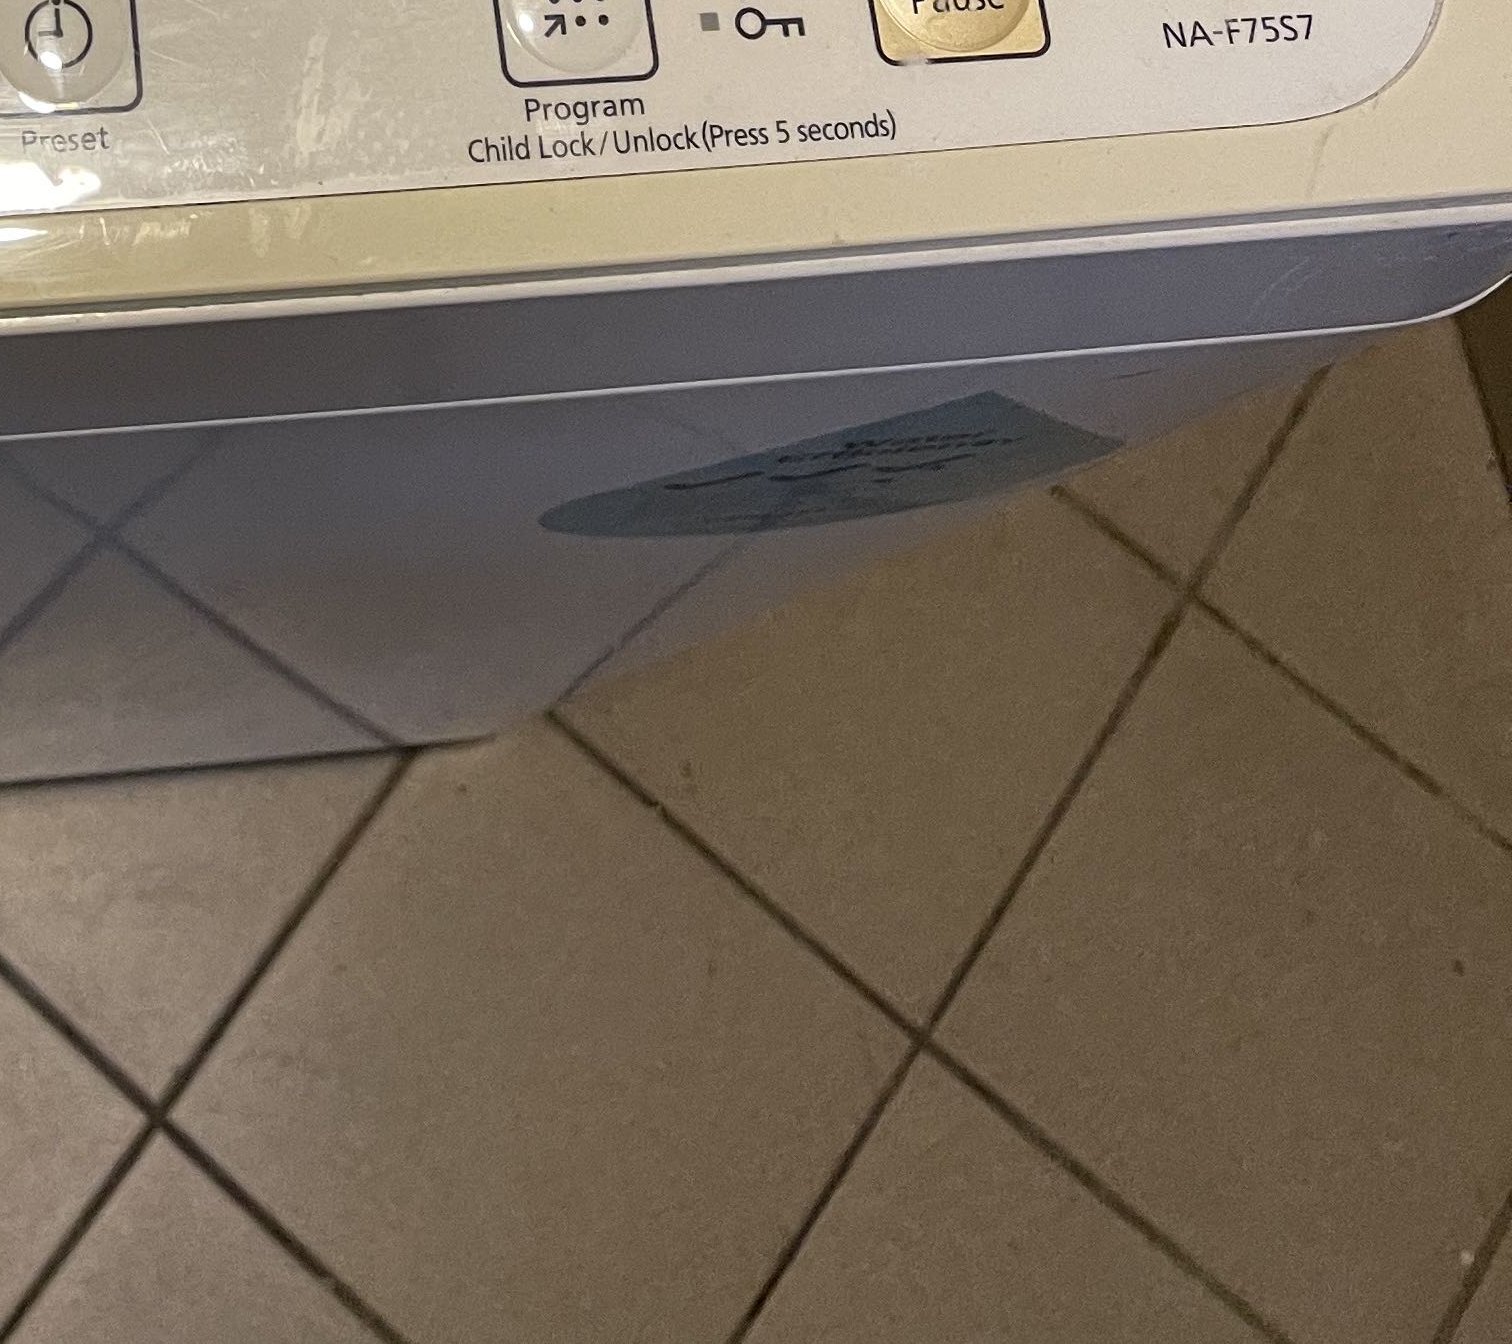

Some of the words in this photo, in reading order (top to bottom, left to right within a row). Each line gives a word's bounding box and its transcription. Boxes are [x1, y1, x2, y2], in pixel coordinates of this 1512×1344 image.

[1162, 15, 1313, 48] NA-F75S7
[524, 97, 645, 125] Program
[22, 127, 110, 152] Preset
[468, 134, 530, 163] Child
[776, 120, 788, 143] 5
[797, 109, 896, 143] seconds)
